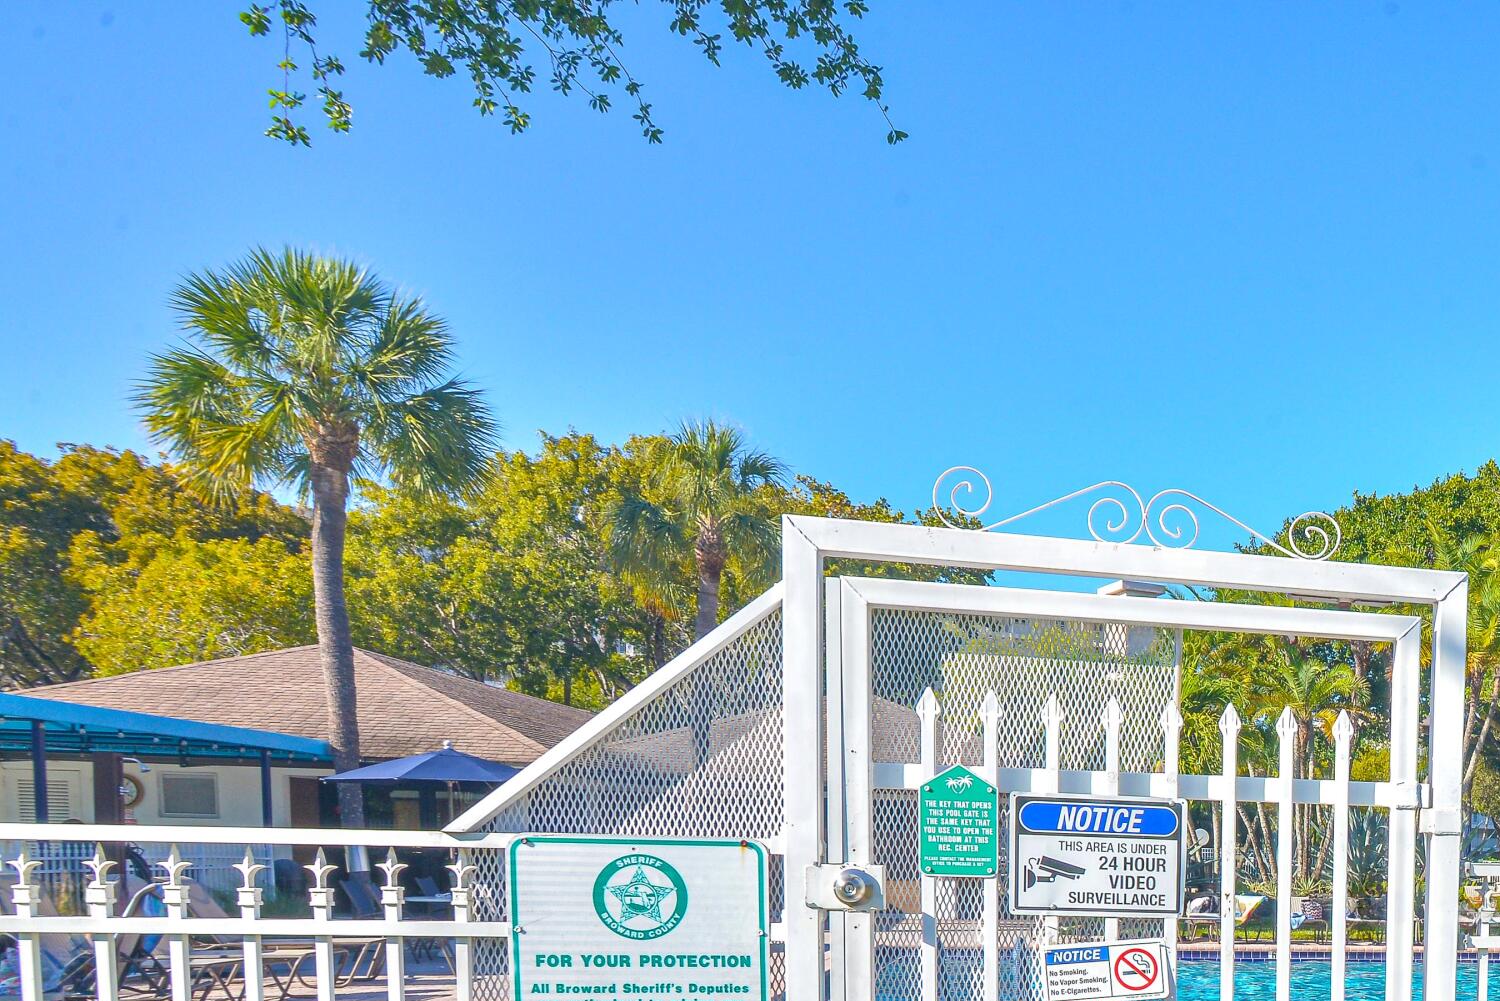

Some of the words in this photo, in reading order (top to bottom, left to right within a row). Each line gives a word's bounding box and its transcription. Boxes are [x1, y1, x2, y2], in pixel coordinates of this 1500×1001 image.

[1057, 806, 1144, 833] NOTICE
[1059, 841, 1082, 851] THIS
[1086, 842, 1113, 853] AREA
[1117, 843, 1126, 853] IS
[1130, 843, 1167, 855] UNDER
[616, 856, 663, 868] SHERIFF
[1099, 856, 1118, 870] 24
[1123, 857, 1166, 872] HOUR
[1109, 875, 1155, 890] VIDEO
[1068, 892, 1166, 906] SURVEILLANCE
[601, 912, 644, 938] BROWARD
[649, 913, 680, 937] COUNTY
[536, 955, 572, 967] FOR
[581, 955, 630, 967] YOUR
[640, 955, 751, 967] PROTECTION
[1053, 949, 1101, 962] NOTICE
[1059, 968, 1088, 976] Smoking.
[1079, 976, 1108, 984] Smoking.
[532, 984, 549, 993] All
[556, 984, 616, 993] Broward
[623, 984, 682, 993] Sheriff's
[689, 984, 749, 995] Deputies
[1061, 987, 1101, 995] E-Cigarettes.
